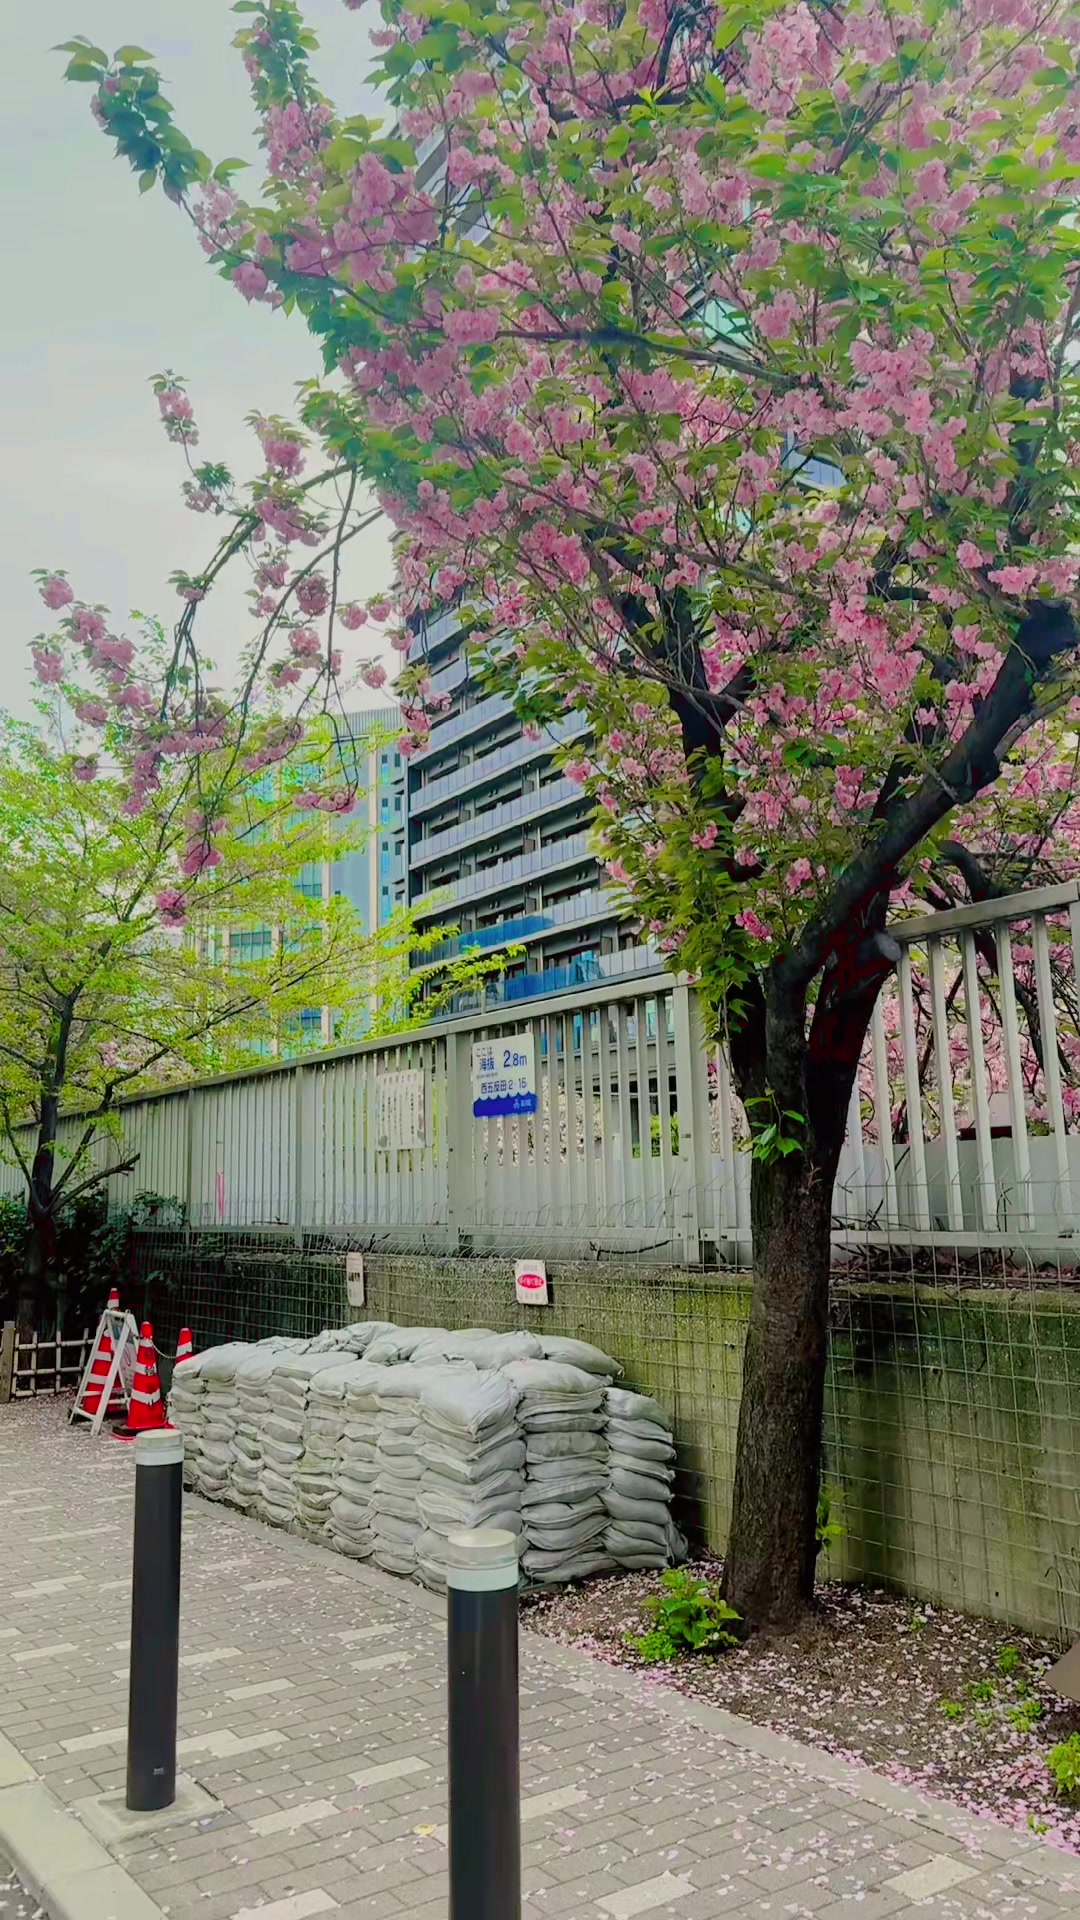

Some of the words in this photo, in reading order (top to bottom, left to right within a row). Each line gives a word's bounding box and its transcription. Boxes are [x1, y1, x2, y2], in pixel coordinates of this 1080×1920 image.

[476, 1046, 493, 1058] ここは
[479, 1057, 495, 1071] 海抜
[503, 1049, 527, 1068] 2.8m
